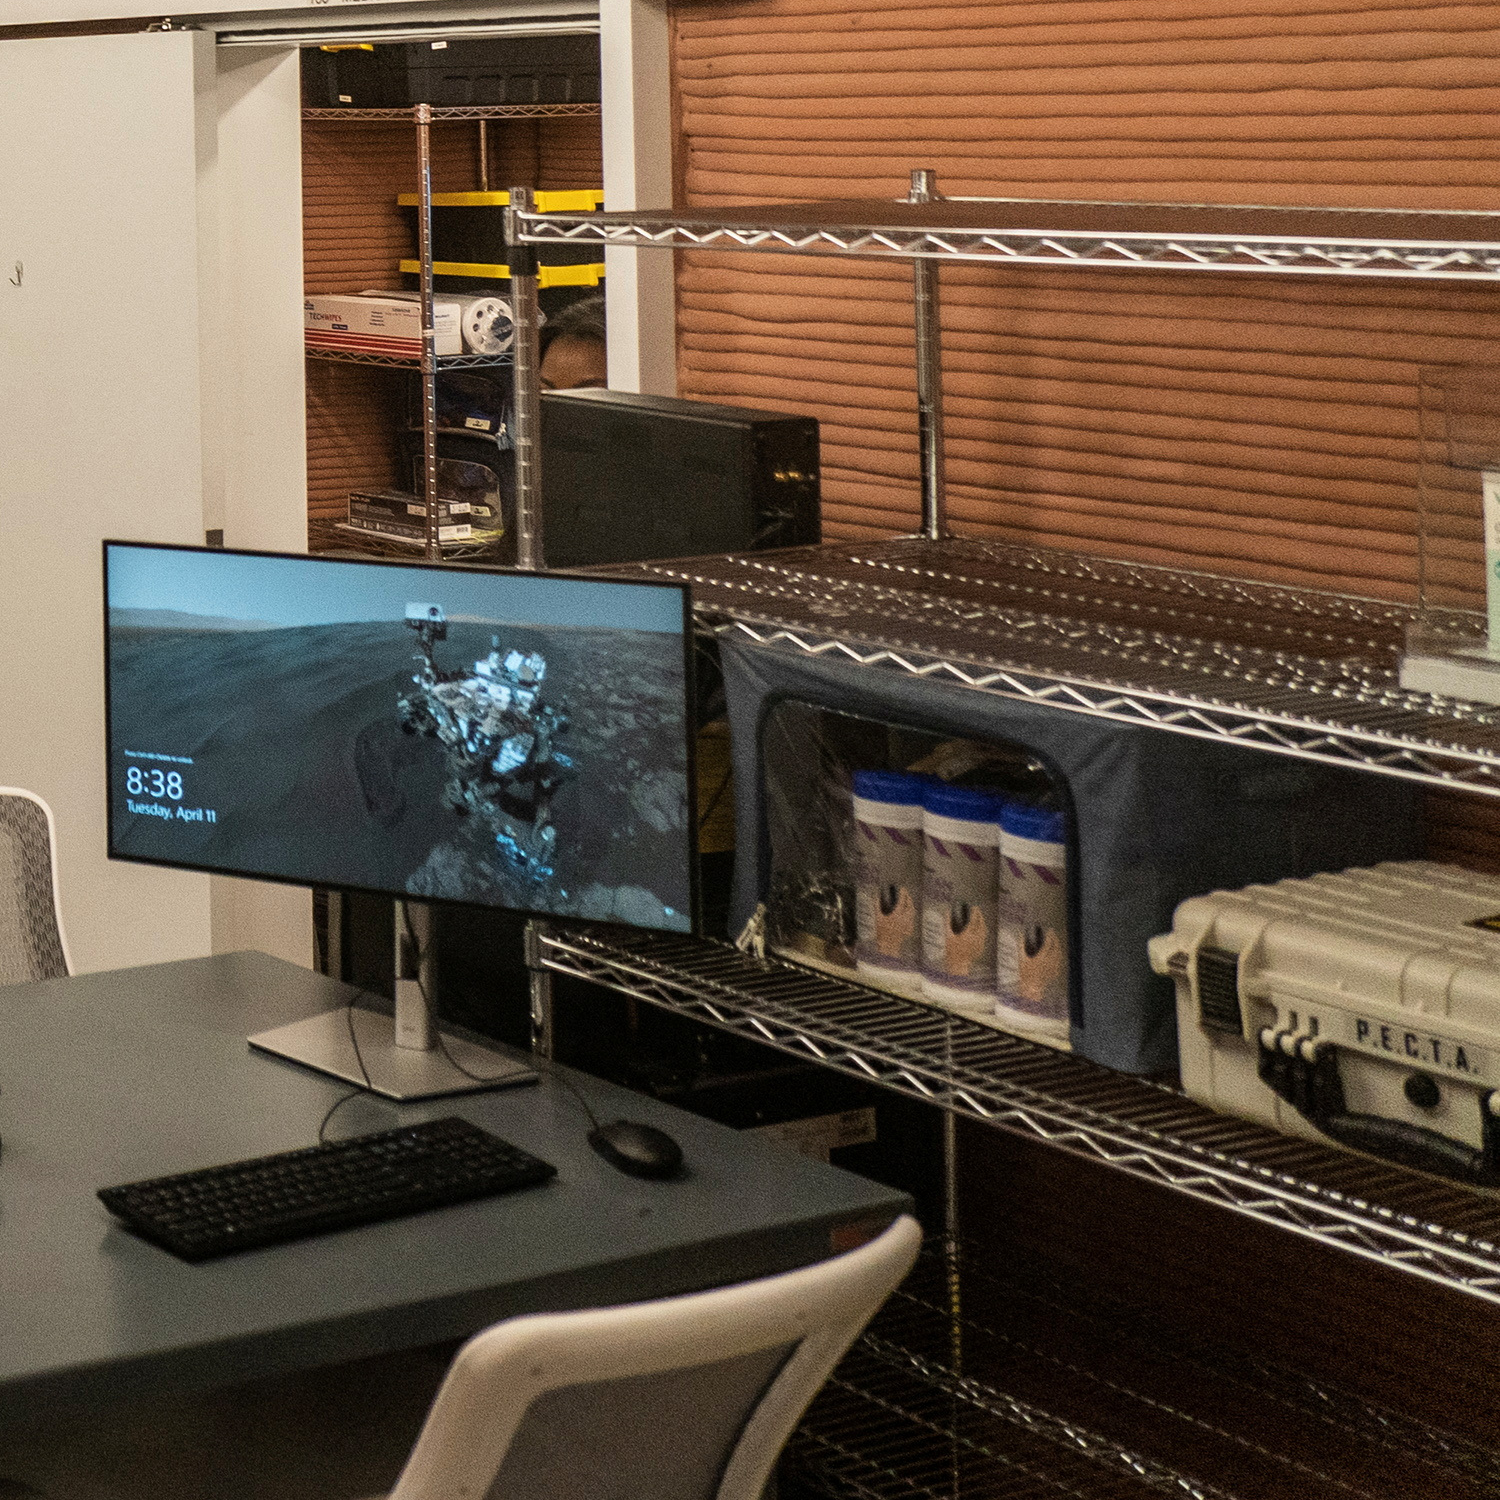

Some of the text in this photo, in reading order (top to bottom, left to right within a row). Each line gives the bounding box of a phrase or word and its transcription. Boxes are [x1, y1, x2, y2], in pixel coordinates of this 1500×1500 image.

[126, 766, 183, 800] 8:38
[126, 798, 217, 823] Tuesday, April 11
